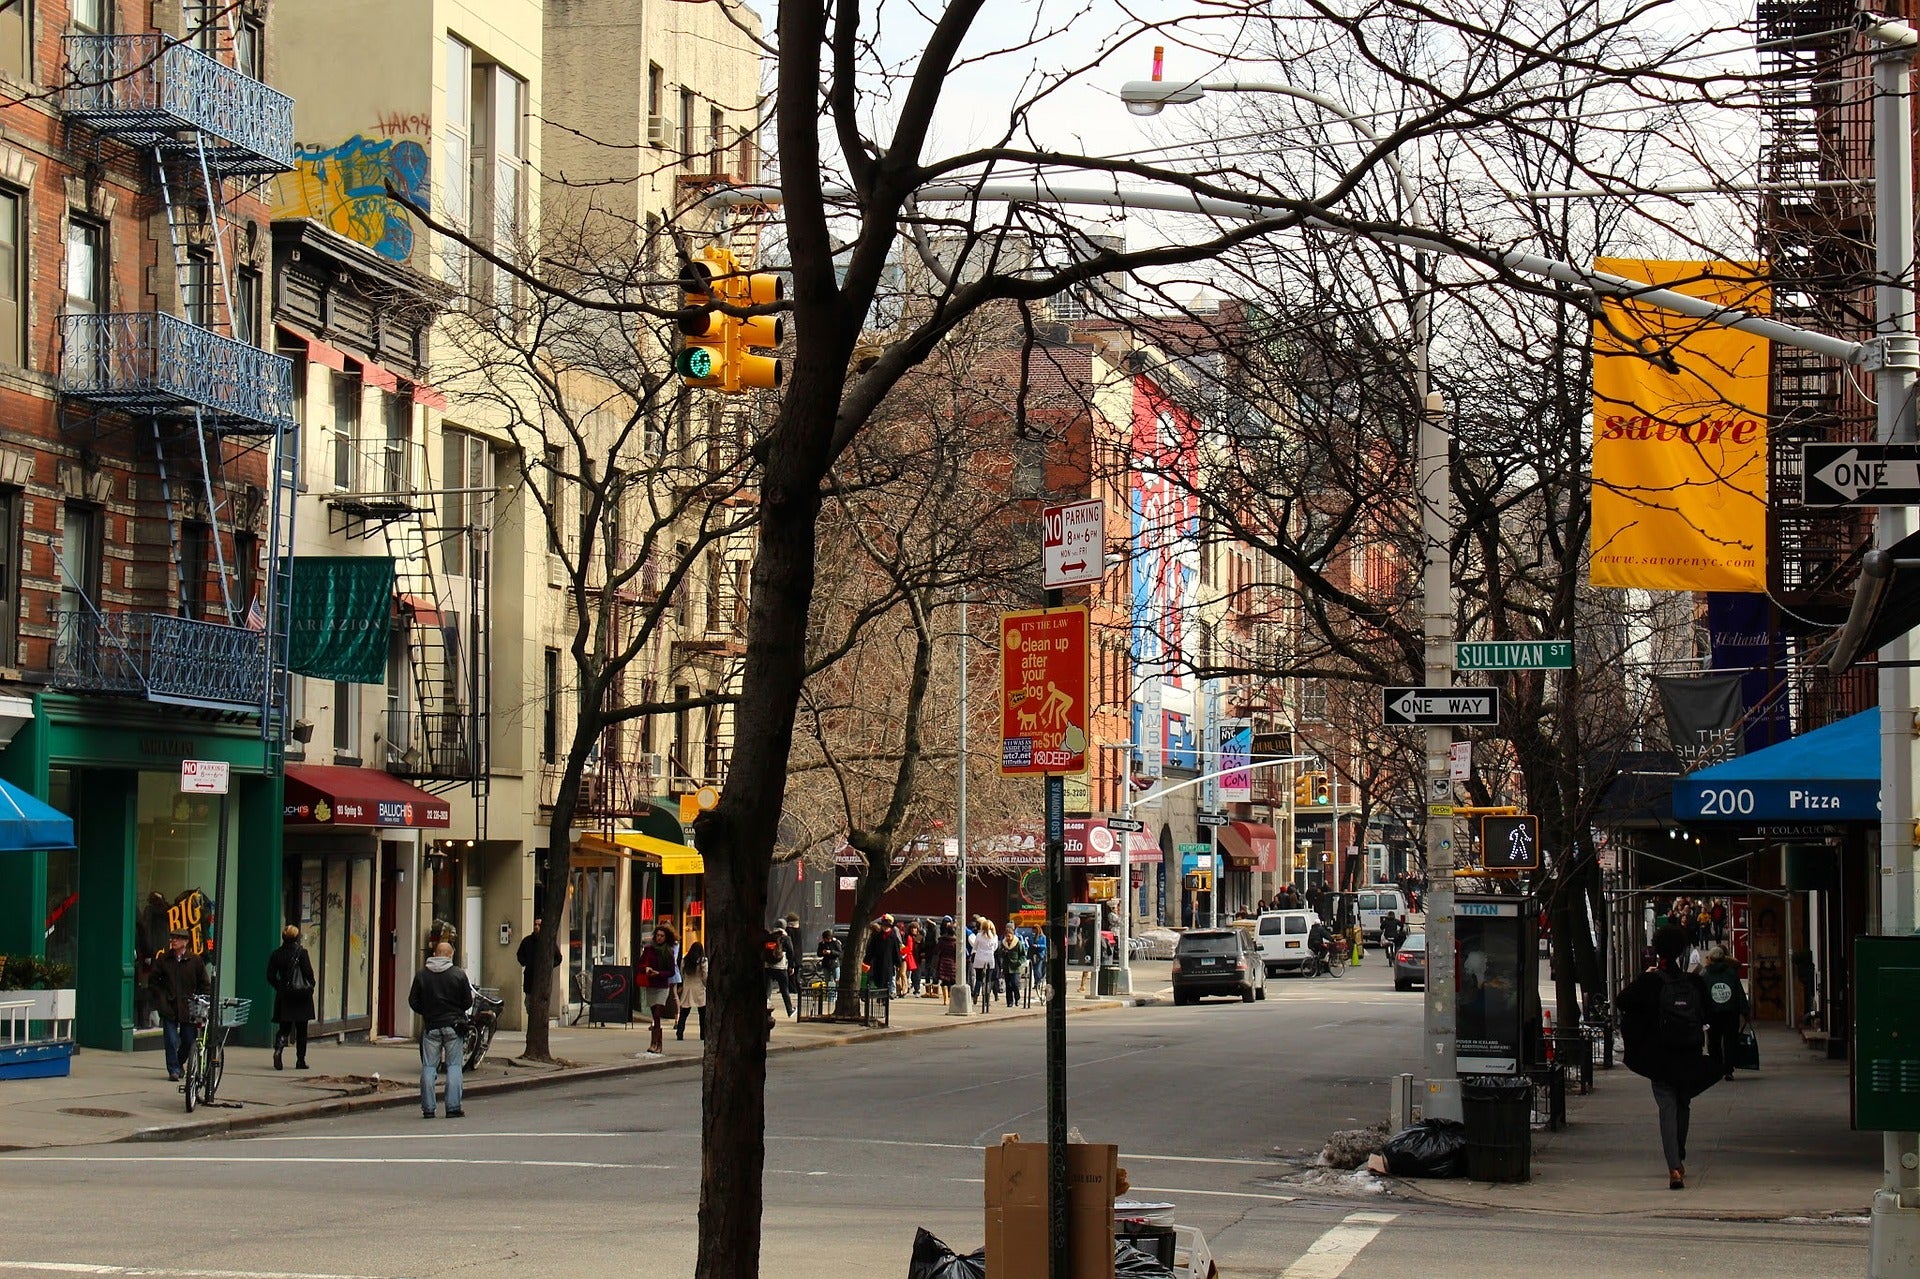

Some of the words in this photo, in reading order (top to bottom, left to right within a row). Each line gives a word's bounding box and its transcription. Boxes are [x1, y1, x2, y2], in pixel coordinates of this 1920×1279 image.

[1603, 413, 1757, 446] savore
[1834, 464, 1889, 487] ONE
[1065, 506, 1099, 526] PARKING
[1045, 514, 1062, 542] NO
[1600, 554, 1755, 571] www.savorenyc.com
[1021, 622, 1035, 632] IT'S
[1036, 620, 1052, 631] THE
[1053, 618, 1069, 629] LAW
[1021, 636, 1051, 653] clean
[1055, 638, 1069, 653] up
[1021, 653, 1048, 669] after
[1461, 645, 1544, 667] SULLIVAN
[1550, 644, 1566, 655] ST
[1021, 668, 1047, 685] your
[1022, 683, 1044, 700] dog
[1401, 699, 1433, 714] ONE
[1449, 699, 1483, 714] WAY
[1695, 728, 1736, 742] THE
[1003, 752, 1031, 760] wtc7.net
[1674, 744, 1737, 758] SHADE
[184, 762, 197, 774] NO
[200, 764, 225, 772] PARKING
[1051, 782, 1061, 793] AS
[379, 803, 413, 818] BALUCHI'S
[1051, 794, 1061, 820] KNOWN
[1699, 789, 1755, 815] 200
[1051, 821, 1061, 840] ALSO
[167, 890, 202, 932] BIG
[1461, 904, 1498, 915] TITAN
